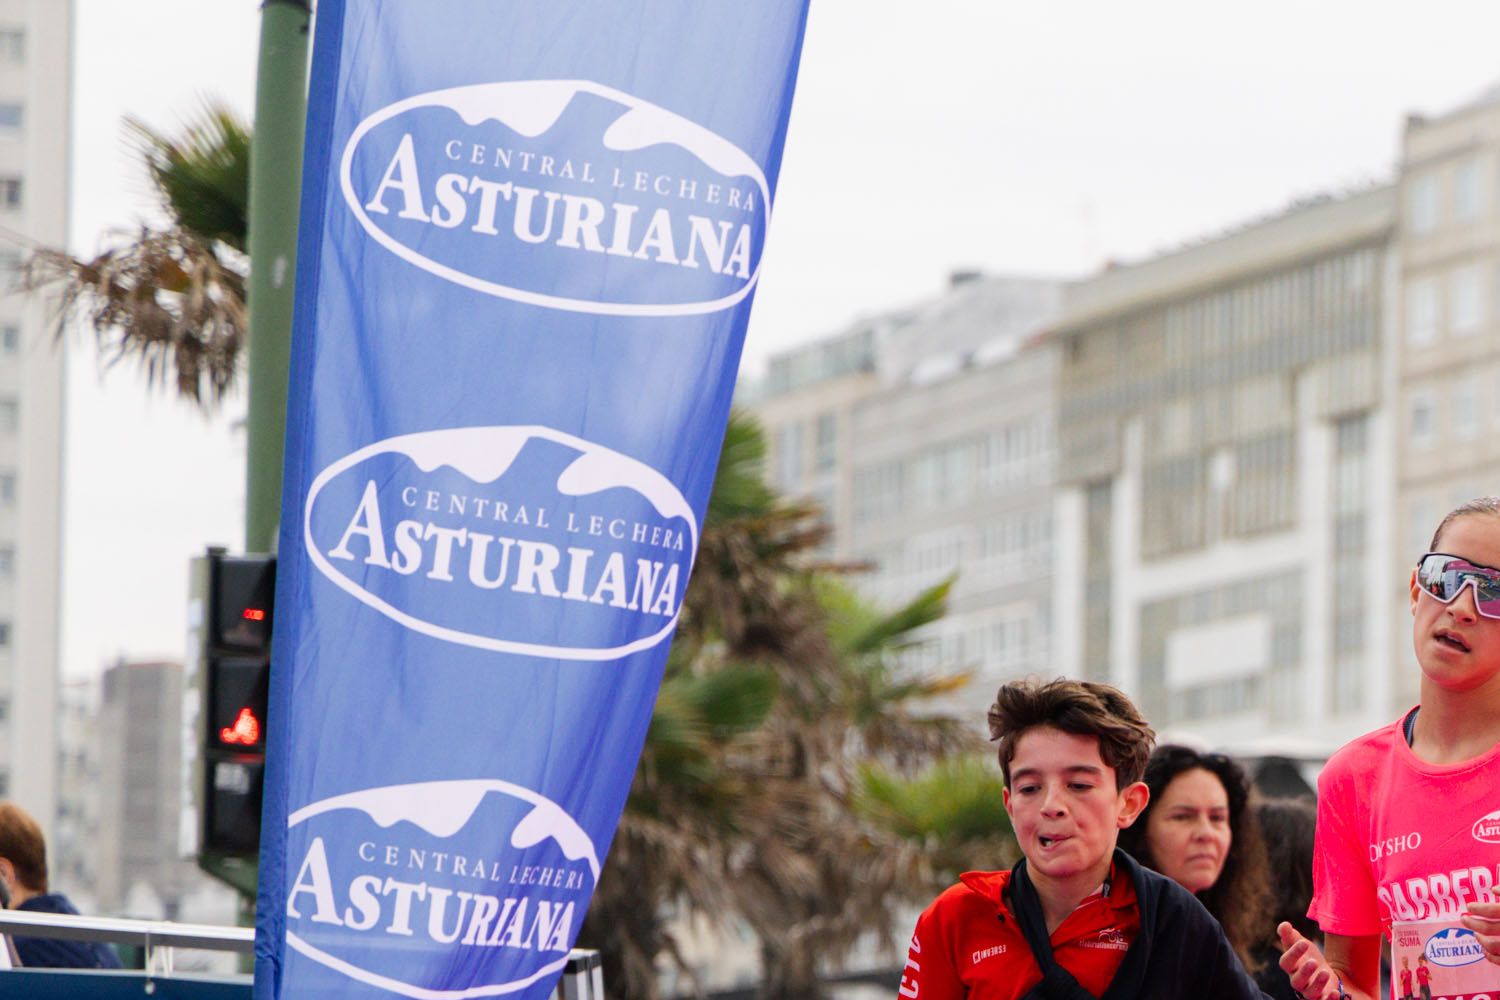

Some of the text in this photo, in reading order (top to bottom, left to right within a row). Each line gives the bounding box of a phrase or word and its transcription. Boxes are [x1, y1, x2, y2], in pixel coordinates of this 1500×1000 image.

[365, 133, 752, 280] ASTURIANA
[445, 140, 756, 213] CENTRAL LECHERA
[328, 480, 682, 617] ASTURIANA
[402, 485, 685, 553] CENTRAL LECHERA
[358, 841, 584, 891] CENTRAL LECHERA
[1369, 831, 1422, 863] OYSHO
[286, 836, 577, 952] ASTURIANA
[1399, 937, 1421, 947] SUMA
